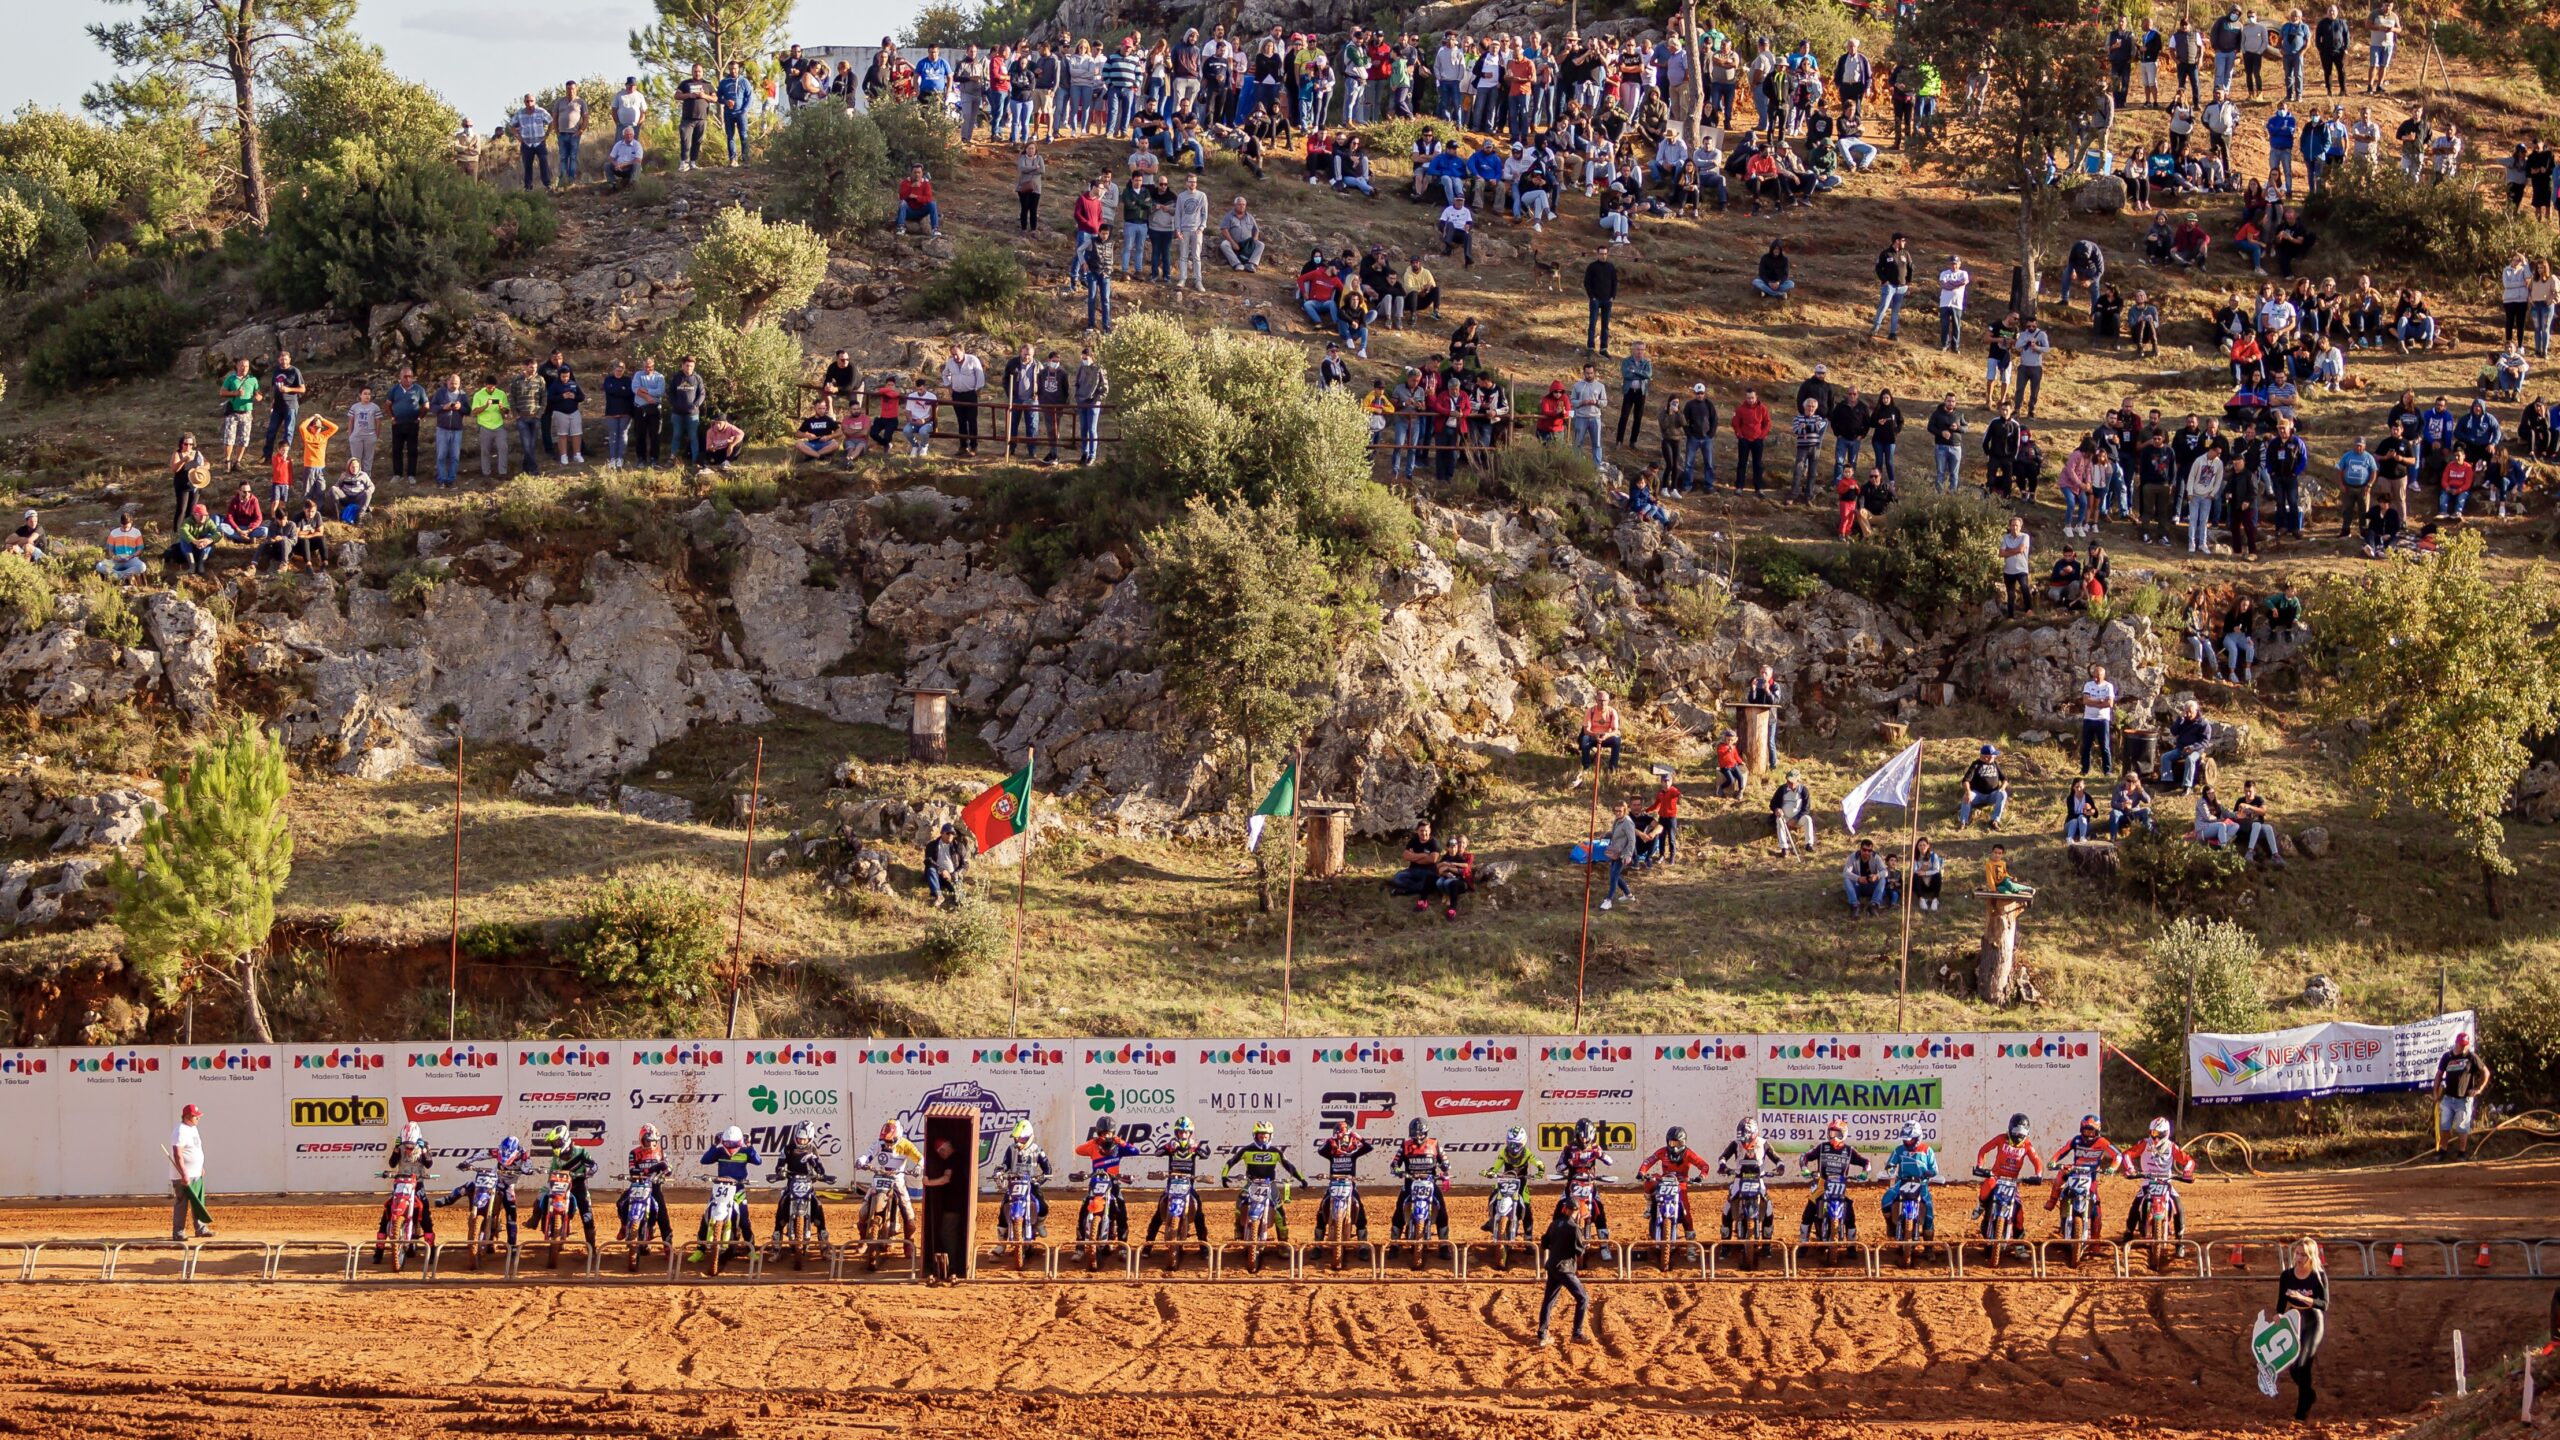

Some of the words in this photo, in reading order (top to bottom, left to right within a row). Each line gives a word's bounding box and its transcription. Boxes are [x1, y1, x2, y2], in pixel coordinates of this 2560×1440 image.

[2395, 1029, 2441, 1040] DECORAÇÃO
[2266, 1044, 2322, 1067] NEXT
[2327, 1039, 2383, 1062] STEP
[2396, 1057, 2438, 1068] OUTDOORS
[2277, 1064, 2372, 1079] PUBLICIDADE
[2396, 1070, 2425, 1078] STANDS
[520, 1092, 611, 1101] CROSSPRO
[647, 1093, 726, 1103] SCOTT
[783, 1089, 838, 1110] JOGOS
[1120, 1089, 1175, 1109] JOGOS
[1540, 1089, 1633, 1099] CROSSPRO
[1761, 1082, 1937, 1107] EDMARMAT
[1211, 1093, 1281, 1108] MOTONI
[1435, 1096, 1511, 1109] Polisport
[294, 1095, 385, 1126] moto
[415, 1102, 491, 1114] Polisport
[1761, 1112, 1828, 1124] MATERIAIS
[1762, 1128, 1786, 1140] 249
[1790, 1128, 1814, 1140] 891
[1856, 1129, 1880, 1140] 919
[296, 1143, 387, 1152] CROSSPRO
[475, 1176, 497, 1188] 525
[1501, 1181, 1519, 1192] 32
[2071, 1177, 2090, 1188] 72
[715, 1187, 728, 1198] 54
[1255, 1188, 1268, 1197] 44
[1413, 1186, 1432, 1197] 939
[1826, 1183, 1846, 1195] 311
